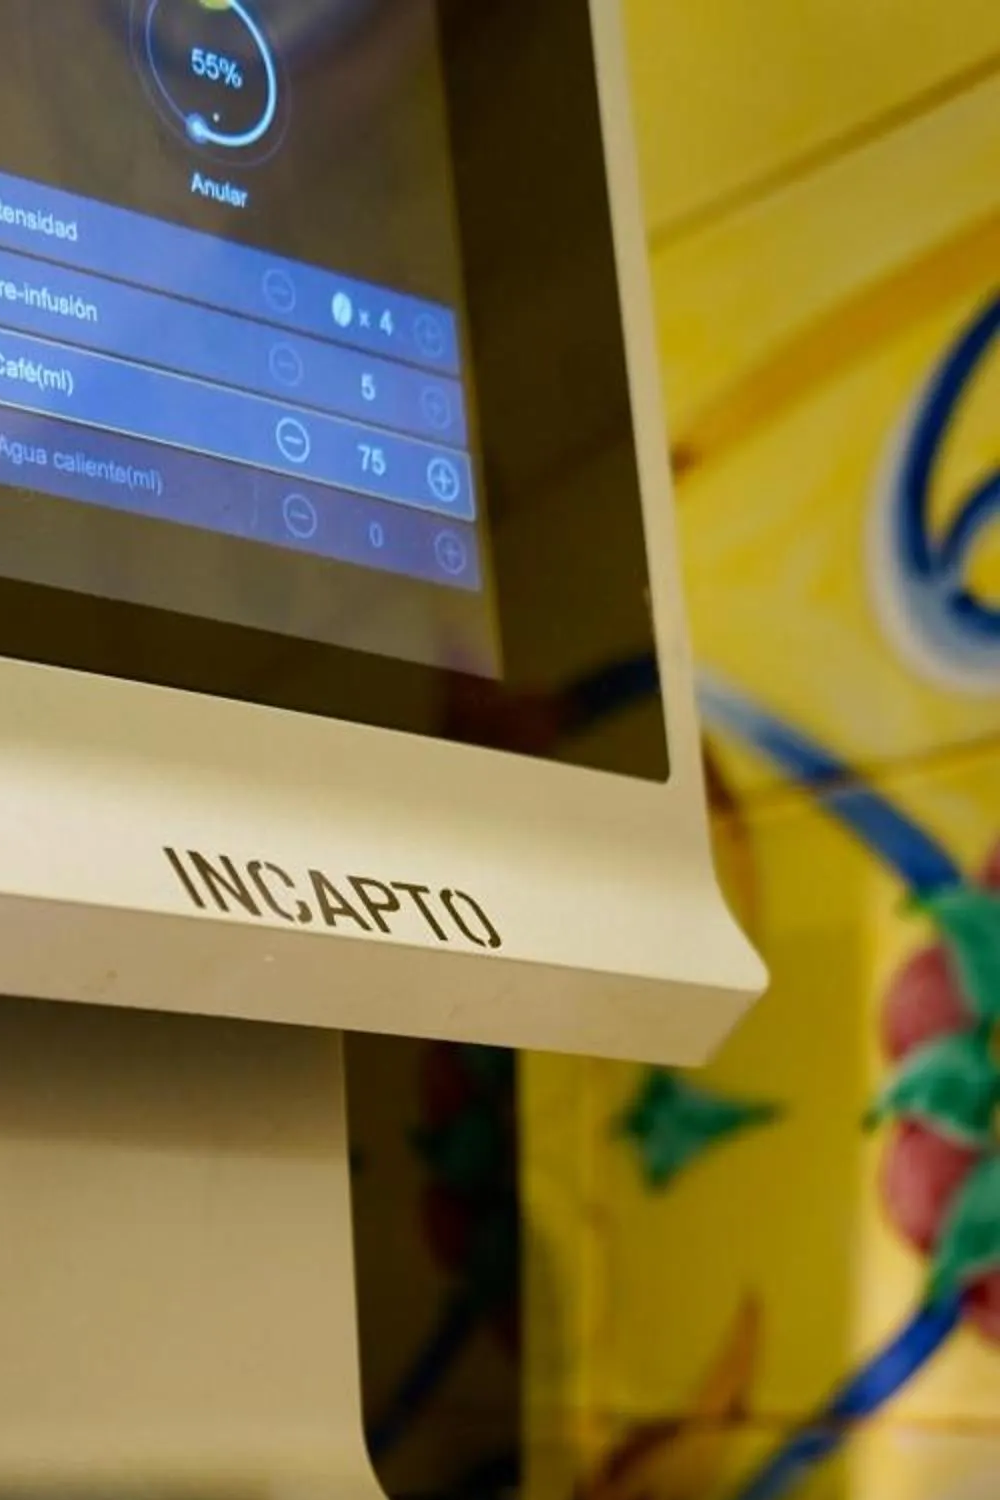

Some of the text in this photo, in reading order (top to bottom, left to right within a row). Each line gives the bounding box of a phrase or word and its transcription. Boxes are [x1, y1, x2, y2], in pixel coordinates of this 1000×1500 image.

[192, 49, 242, 88] 55%
[192, 173, 247, 207] Anular
[380, 310, 393, 335] 4
[361, 374, 375, 400] 5
[53, 451, 162, 496] caliente(ml)
[358, 445, 385, 475] 75
[370, 522, 383, 547] 0
[163, 846, 502, 949] INCAPTO
